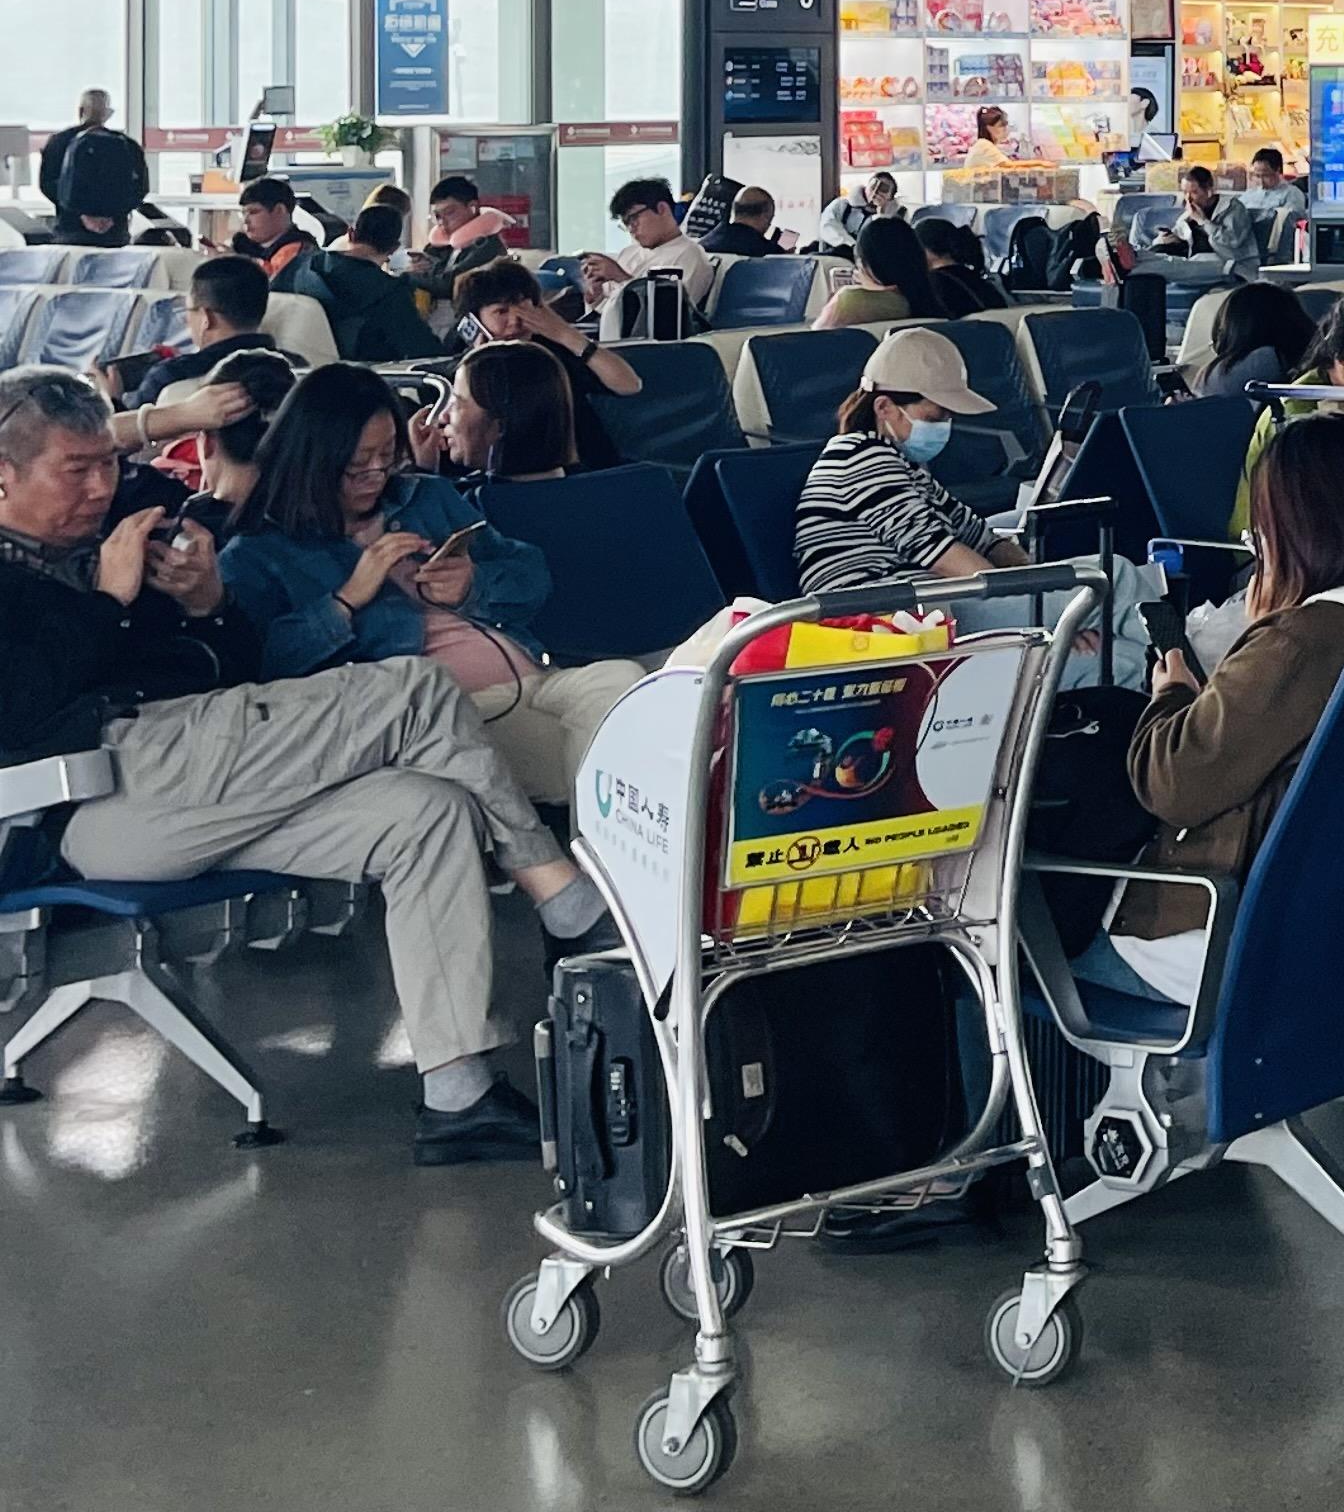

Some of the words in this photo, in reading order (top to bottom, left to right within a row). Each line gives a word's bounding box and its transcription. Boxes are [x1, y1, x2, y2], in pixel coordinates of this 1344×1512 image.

[615, 777, 670, 833] 中国人寿
[615, 808, 644, 839] CHINA
[646, 830, 669, 855] LIFE
